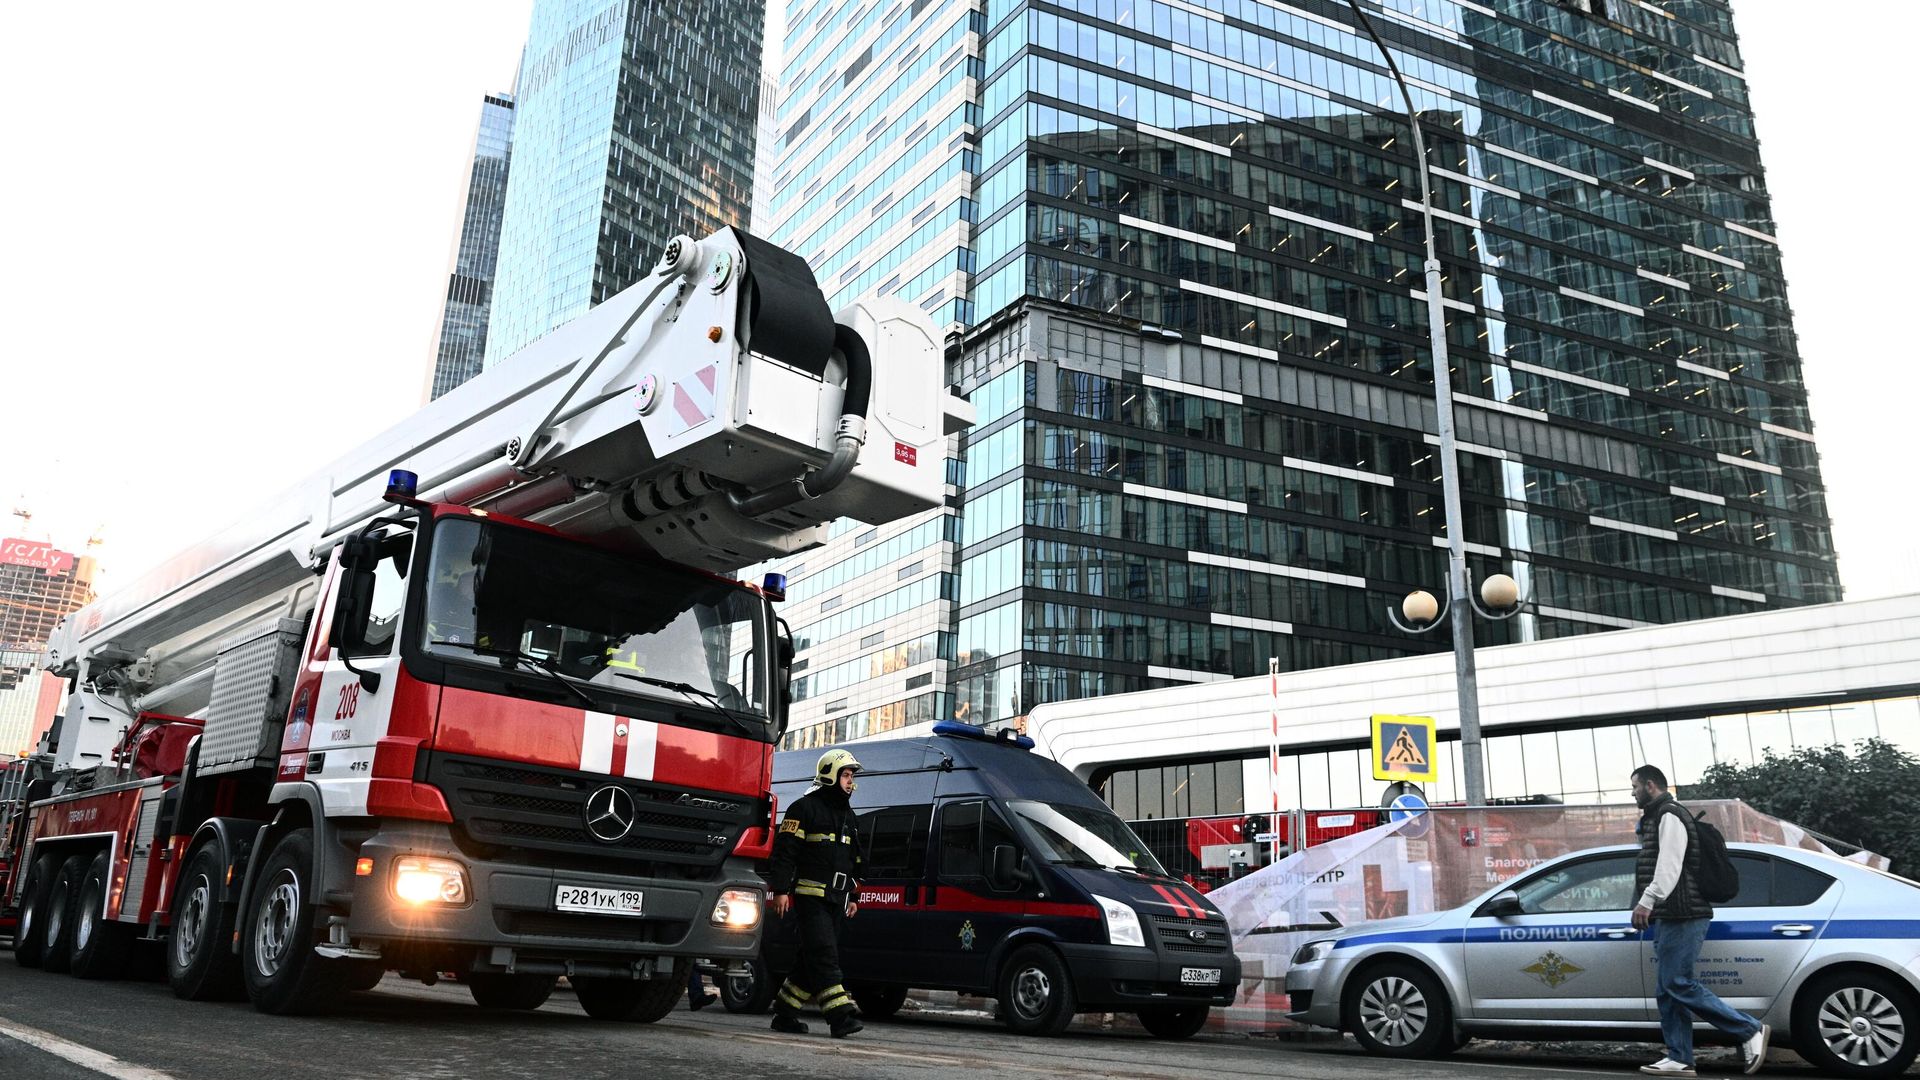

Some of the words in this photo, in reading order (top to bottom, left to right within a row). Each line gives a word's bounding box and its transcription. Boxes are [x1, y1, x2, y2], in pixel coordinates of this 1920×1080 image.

[335, 682, 360, 720] 208
[330, 729, 351, 741] МОСКВА
[781, 821, 797, 831] 2078
[619, 892, 640, 904] 199
[858, 891, 900, 904] ДЕРАЦИИ
[1500, 926, 1596, 940] ПОЛИЦИЯ
[1700, 970, 1739, 978] ДОВЕРИЯ
